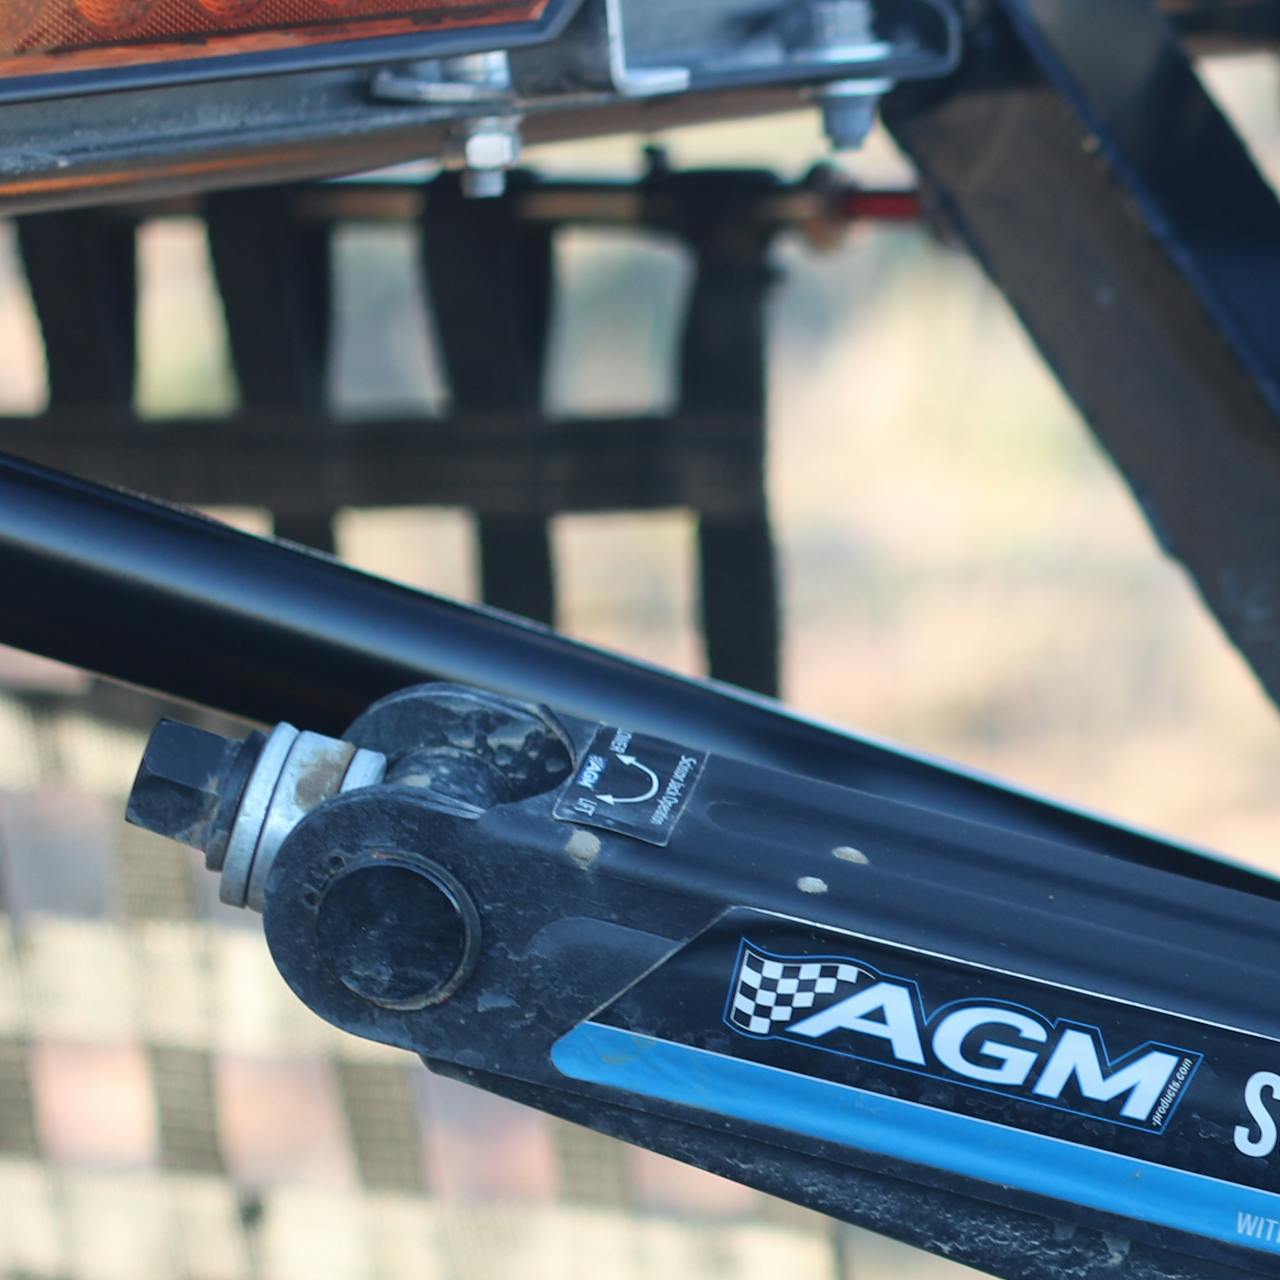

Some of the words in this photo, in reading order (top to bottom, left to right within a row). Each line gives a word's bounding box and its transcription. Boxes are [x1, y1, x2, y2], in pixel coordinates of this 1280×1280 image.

[577, 760, 603, 790] AGM
[574, 796, 598, 817] LIFT
[787, 980, 1181, 1120] AGM
